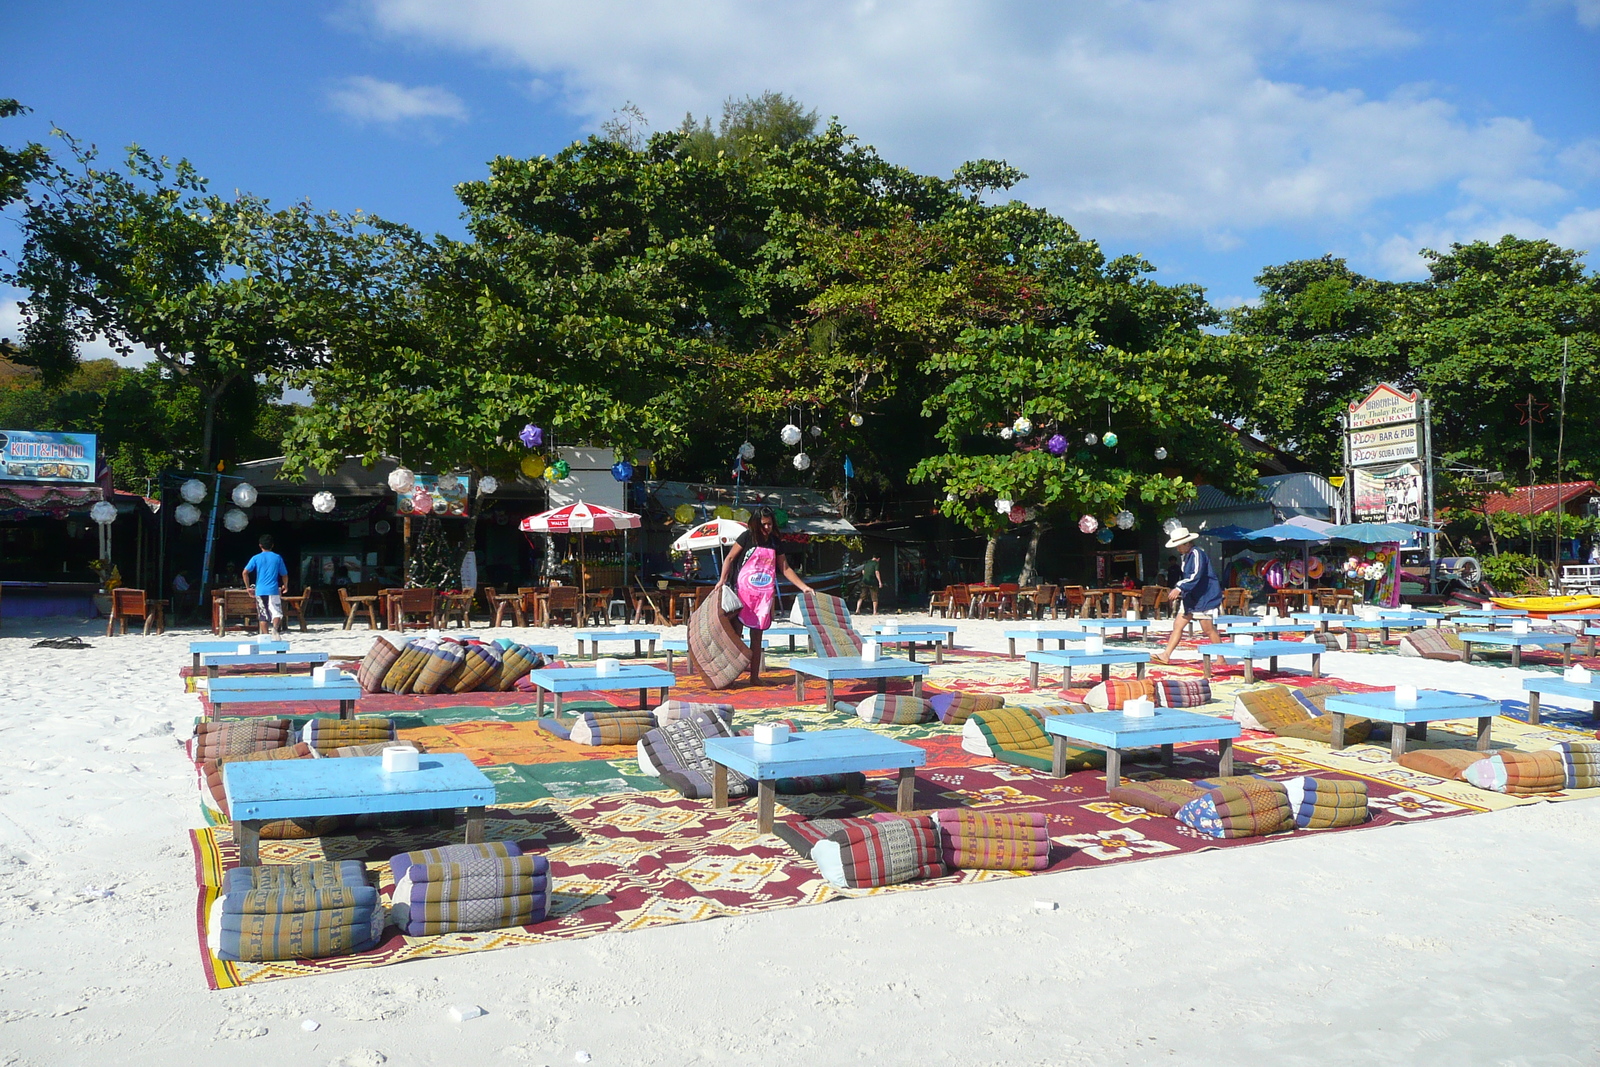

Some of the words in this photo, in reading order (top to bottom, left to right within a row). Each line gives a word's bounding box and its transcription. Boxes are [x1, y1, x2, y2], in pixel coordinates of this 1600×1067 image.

[1353, 413, 1366, 421] Ploy
[1369, 409, 1390, 418] Thalay
[1391, 405, 1413, 415] Resort
[1353, 412, 1413, 427] RESTAURANT
[1379, 432, 1393, 441] BAR
[1394, 430, 1400, 439] &
[1400, 428, 1414, 438] PUB
[1379, 449, 1395, 459] SCUBA
[1396, 446, 1414, 456] DIVING
